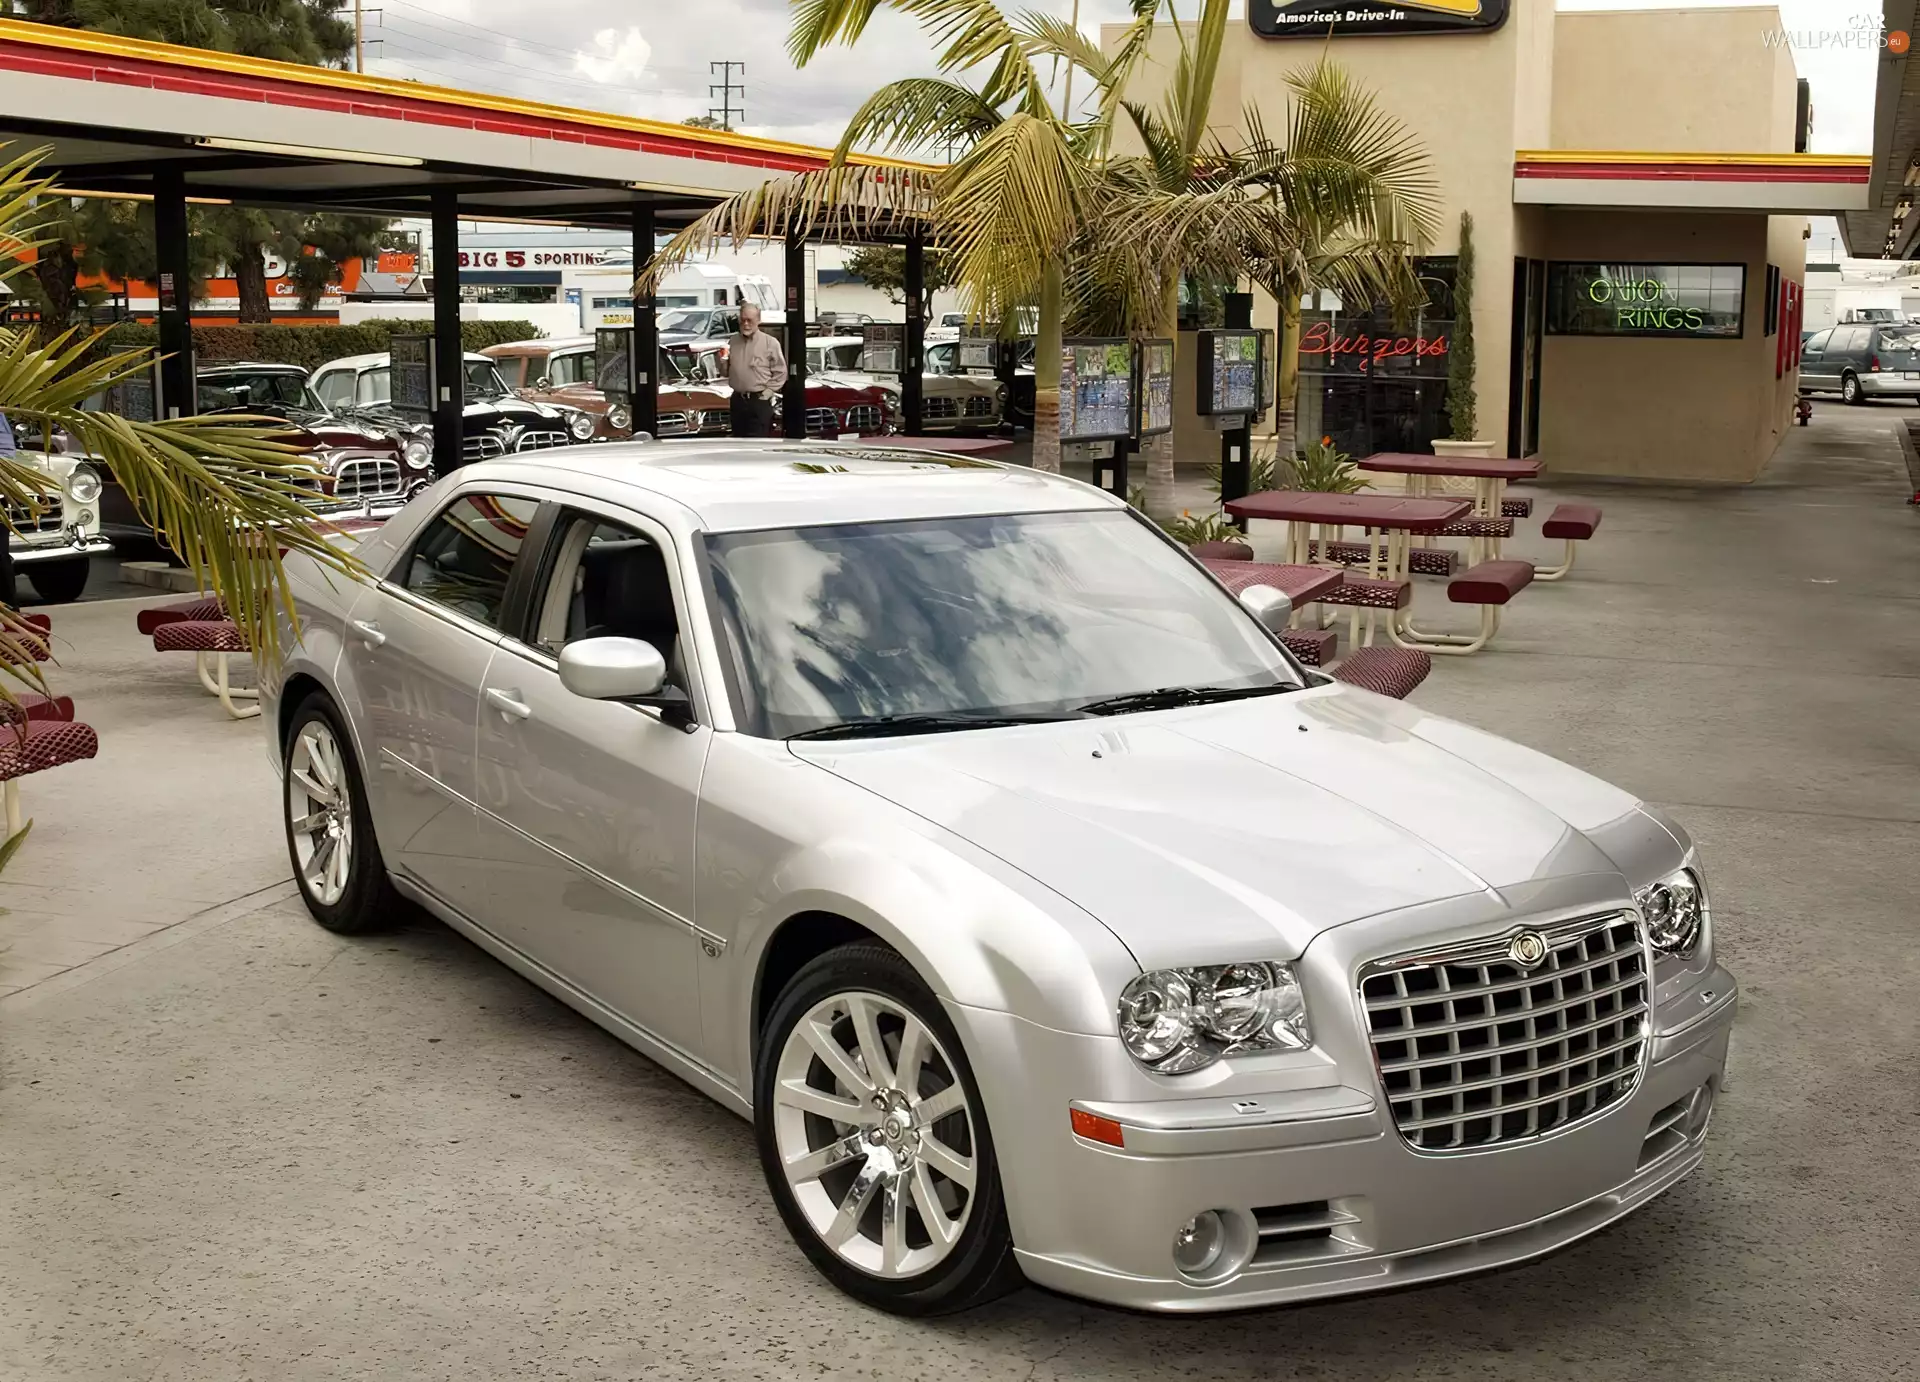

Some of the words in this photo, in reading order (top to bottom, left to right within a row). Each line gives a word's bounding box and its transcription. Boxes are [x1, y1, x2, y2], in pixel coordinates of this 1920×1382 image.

[1276, 10, 1342, 24] America's
[459, 252, 498, 267] BIG
[505, 251, 526, 268] 5
[1589, 279, 1679, 303] ONION
[1617, 307, 1703, 329] RINGS
[1299, 322, 1448, 371] Burgers
